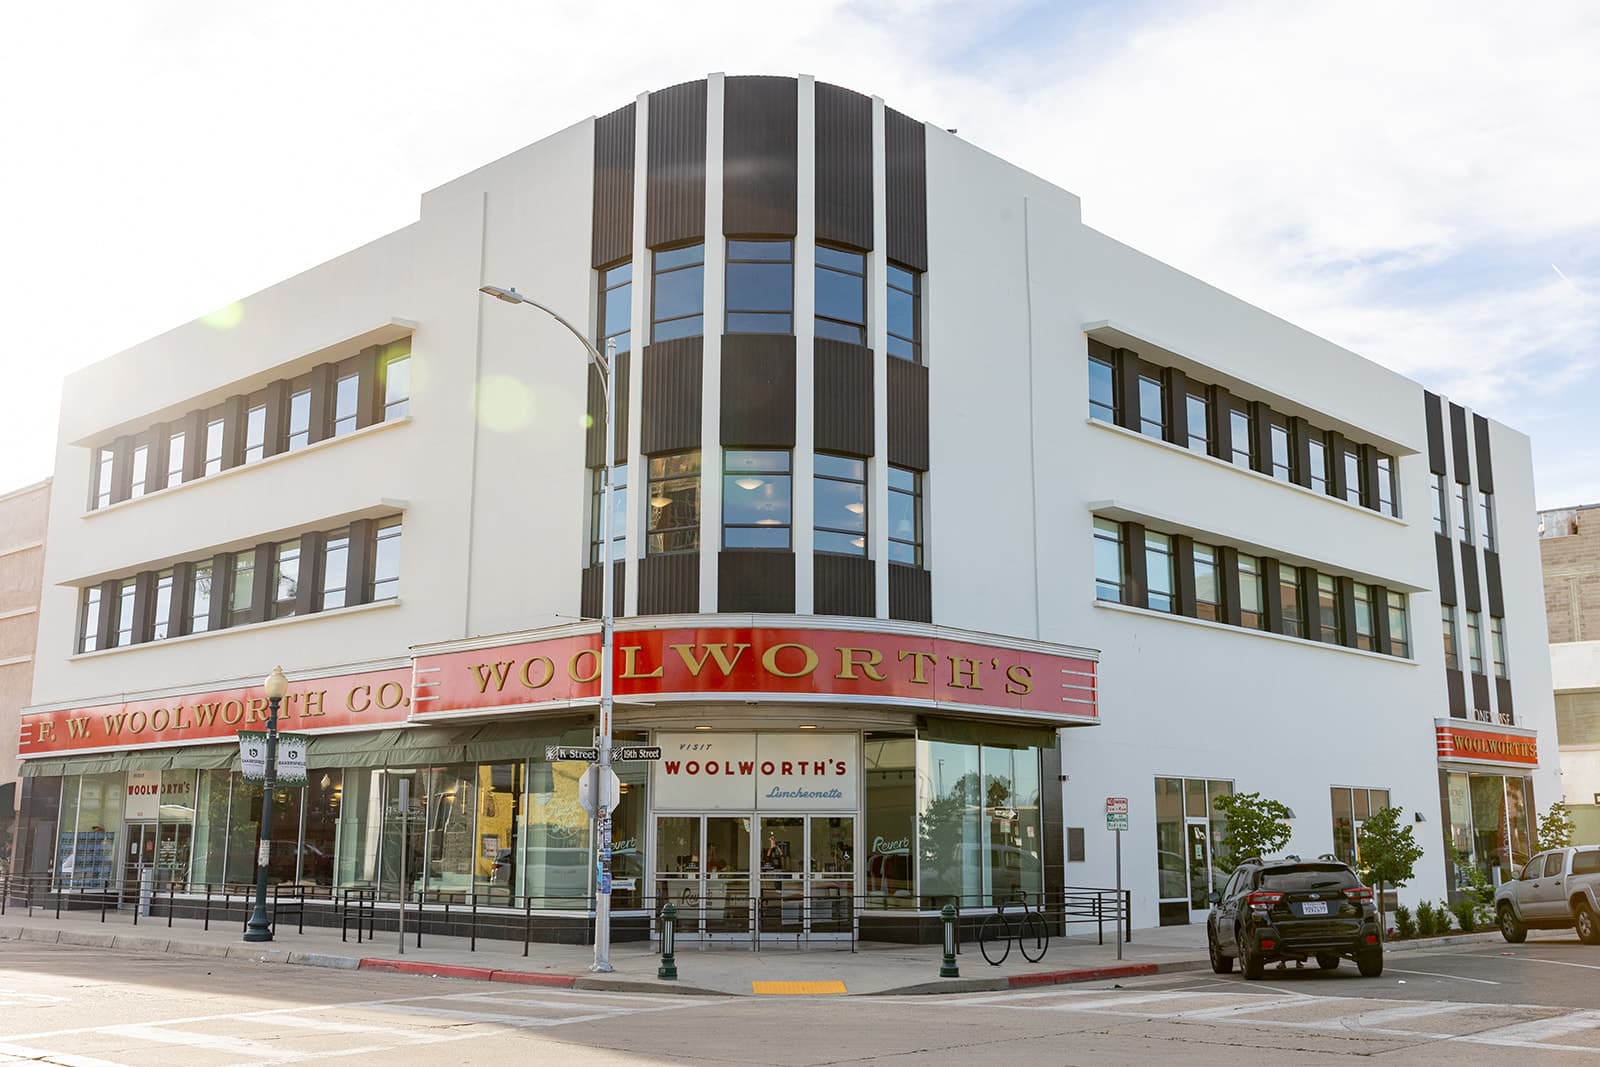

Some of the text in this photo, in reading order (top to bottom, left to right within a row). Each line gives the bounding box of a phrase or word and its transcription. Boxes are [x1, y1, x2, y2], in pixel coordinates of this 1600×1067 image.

[467, 642, 1033, 695] WOOLWORTH'S
[38, 681, 411, 743] F. W. WOOLWORTH CO.
[679, 743, 712, 751] VISIT
[1454, 734, 1536, 757] WOOLWORTH'S
[560, 749, 596, 759] K Street
[623, 748, 660, 759] 19th Street
[665, 758, 847, 775] WOOLWORTH'S
[128, 781, 191, 795] WOOLWORTH'S
[766, 786, 843, 799] Luncheonette
